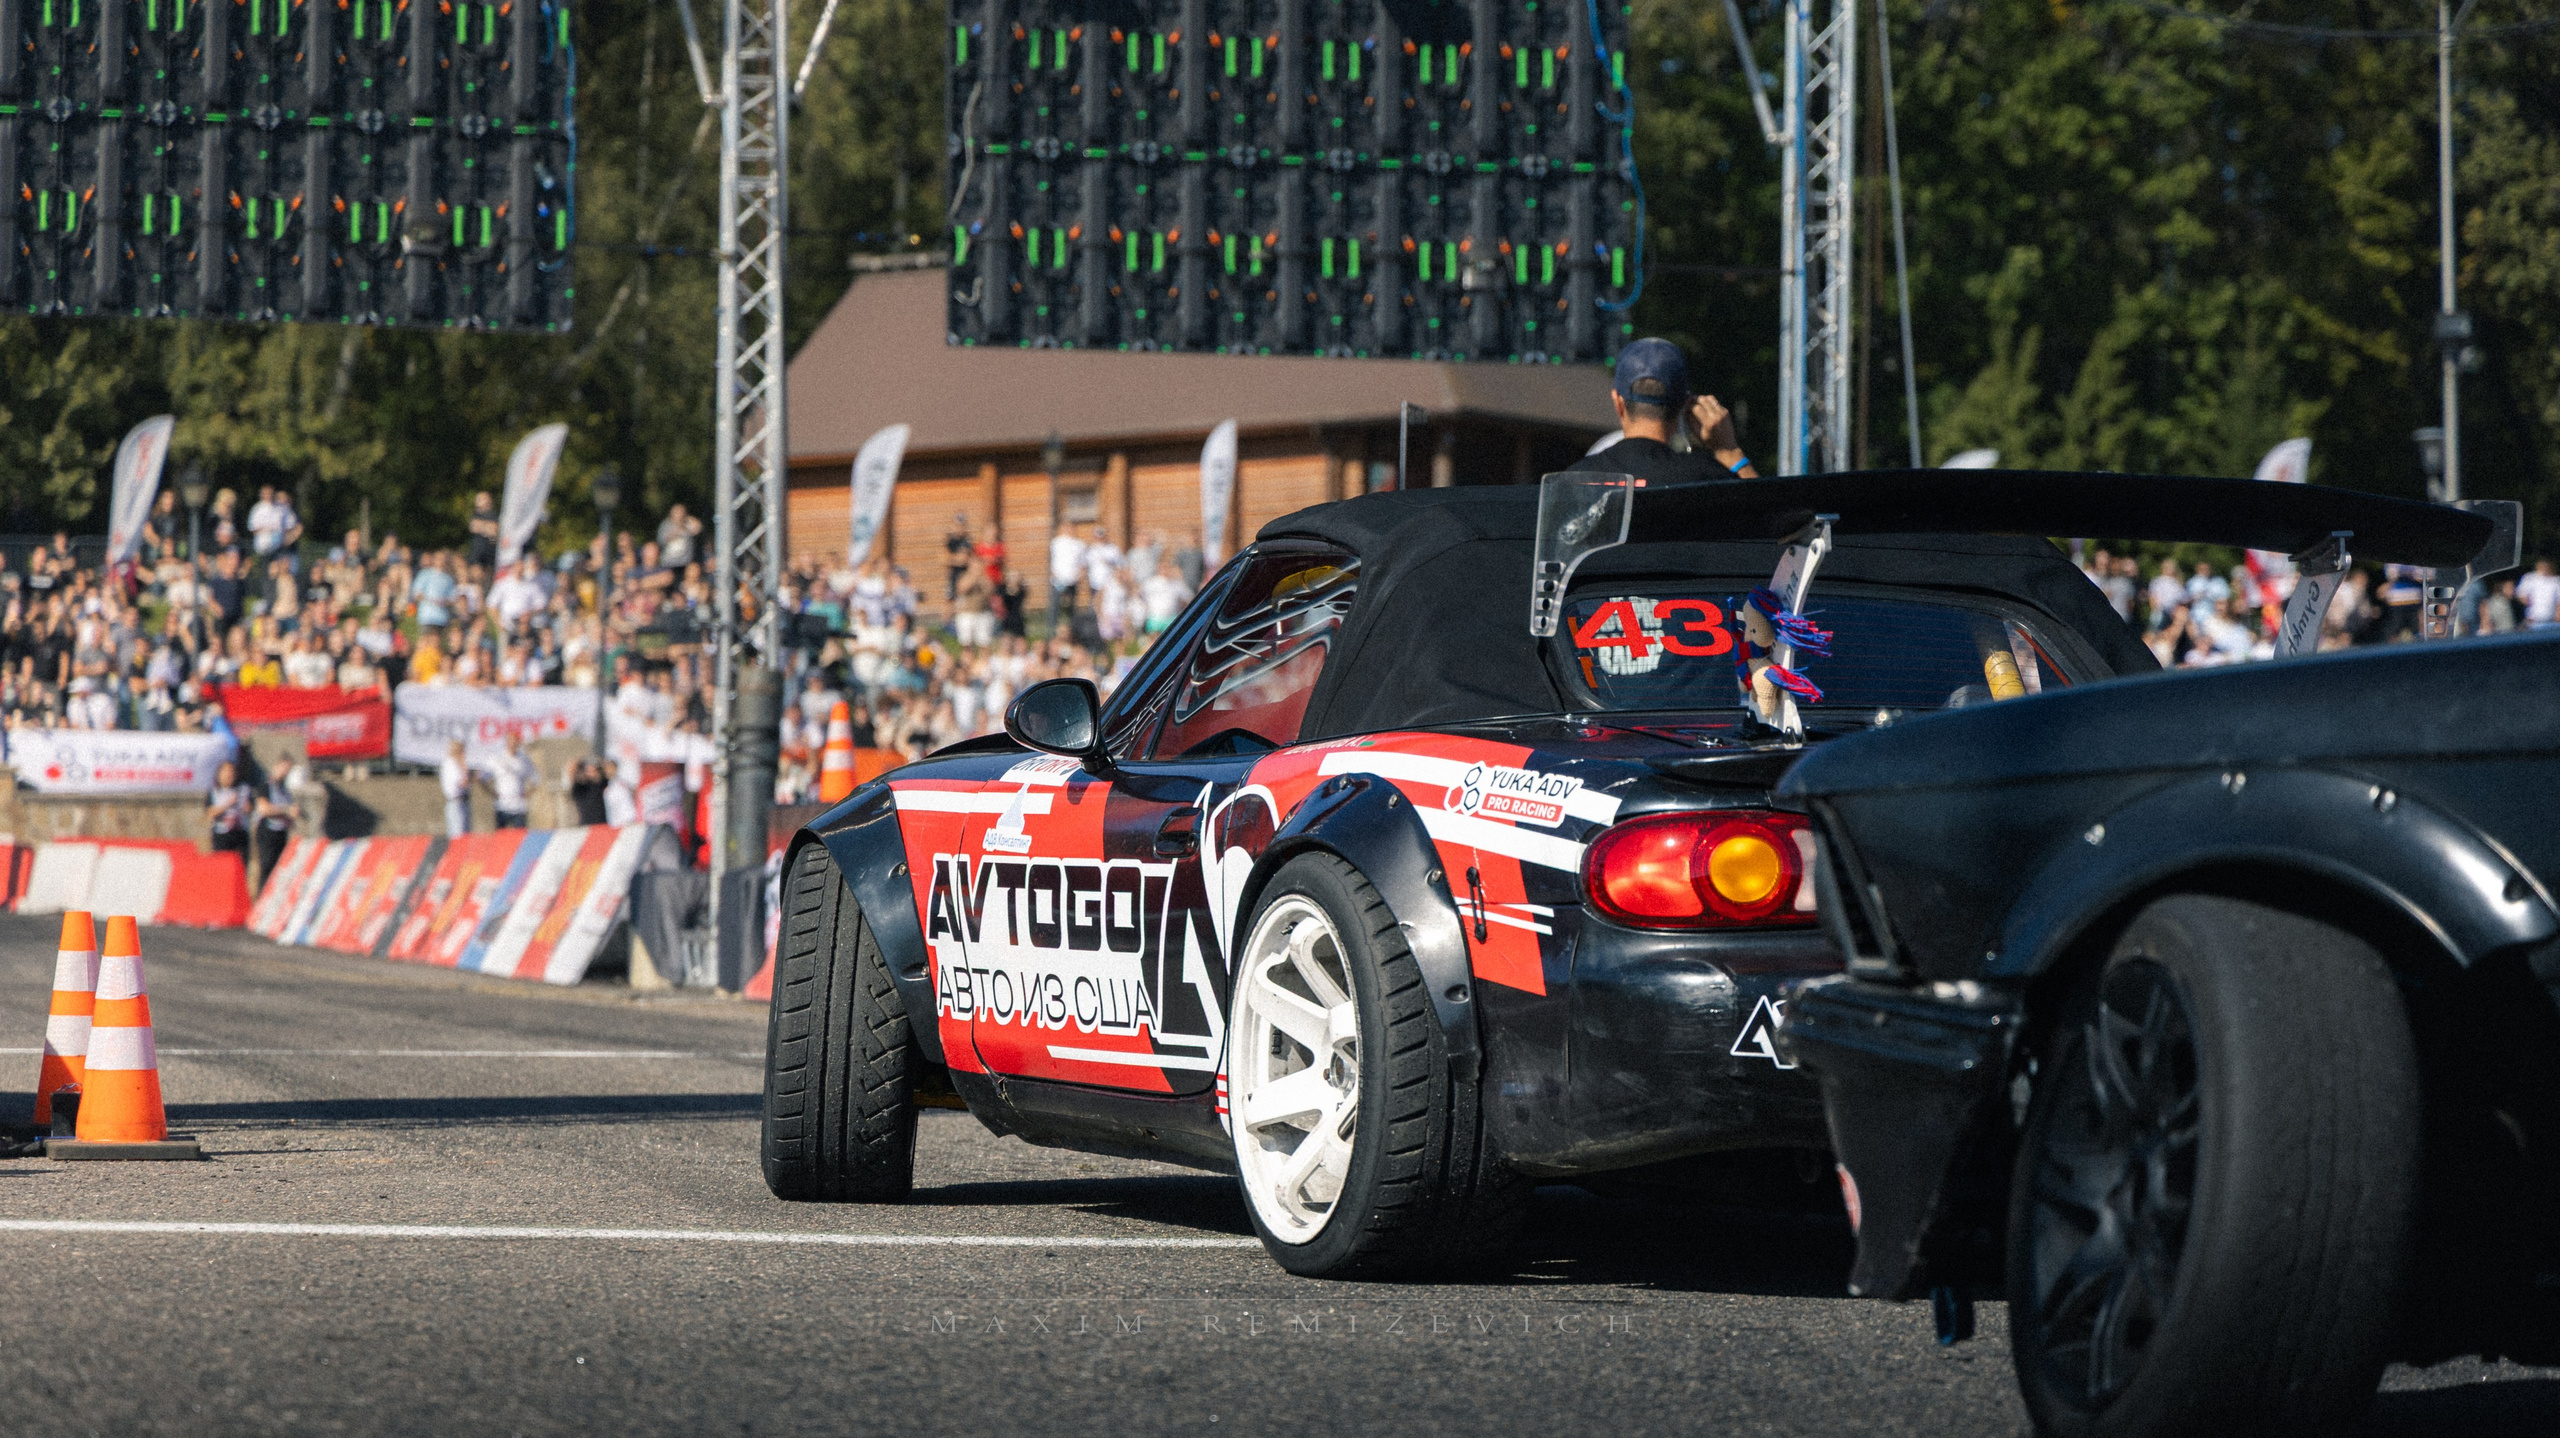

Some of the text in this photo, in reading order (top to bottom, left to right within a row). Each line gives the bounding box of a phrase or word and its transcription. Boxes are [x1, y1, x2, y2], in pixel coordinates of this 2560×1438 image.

[1575, 599, 1733, 658] 43
[1486, 796, 1557, 819] PRO RACING
[1490, 770, 1578, 799] YUKA ADV
[928, 860, 1142, 954] AVTOGO
[938, 965, 1158, 1031] АВТО ИЗ США
